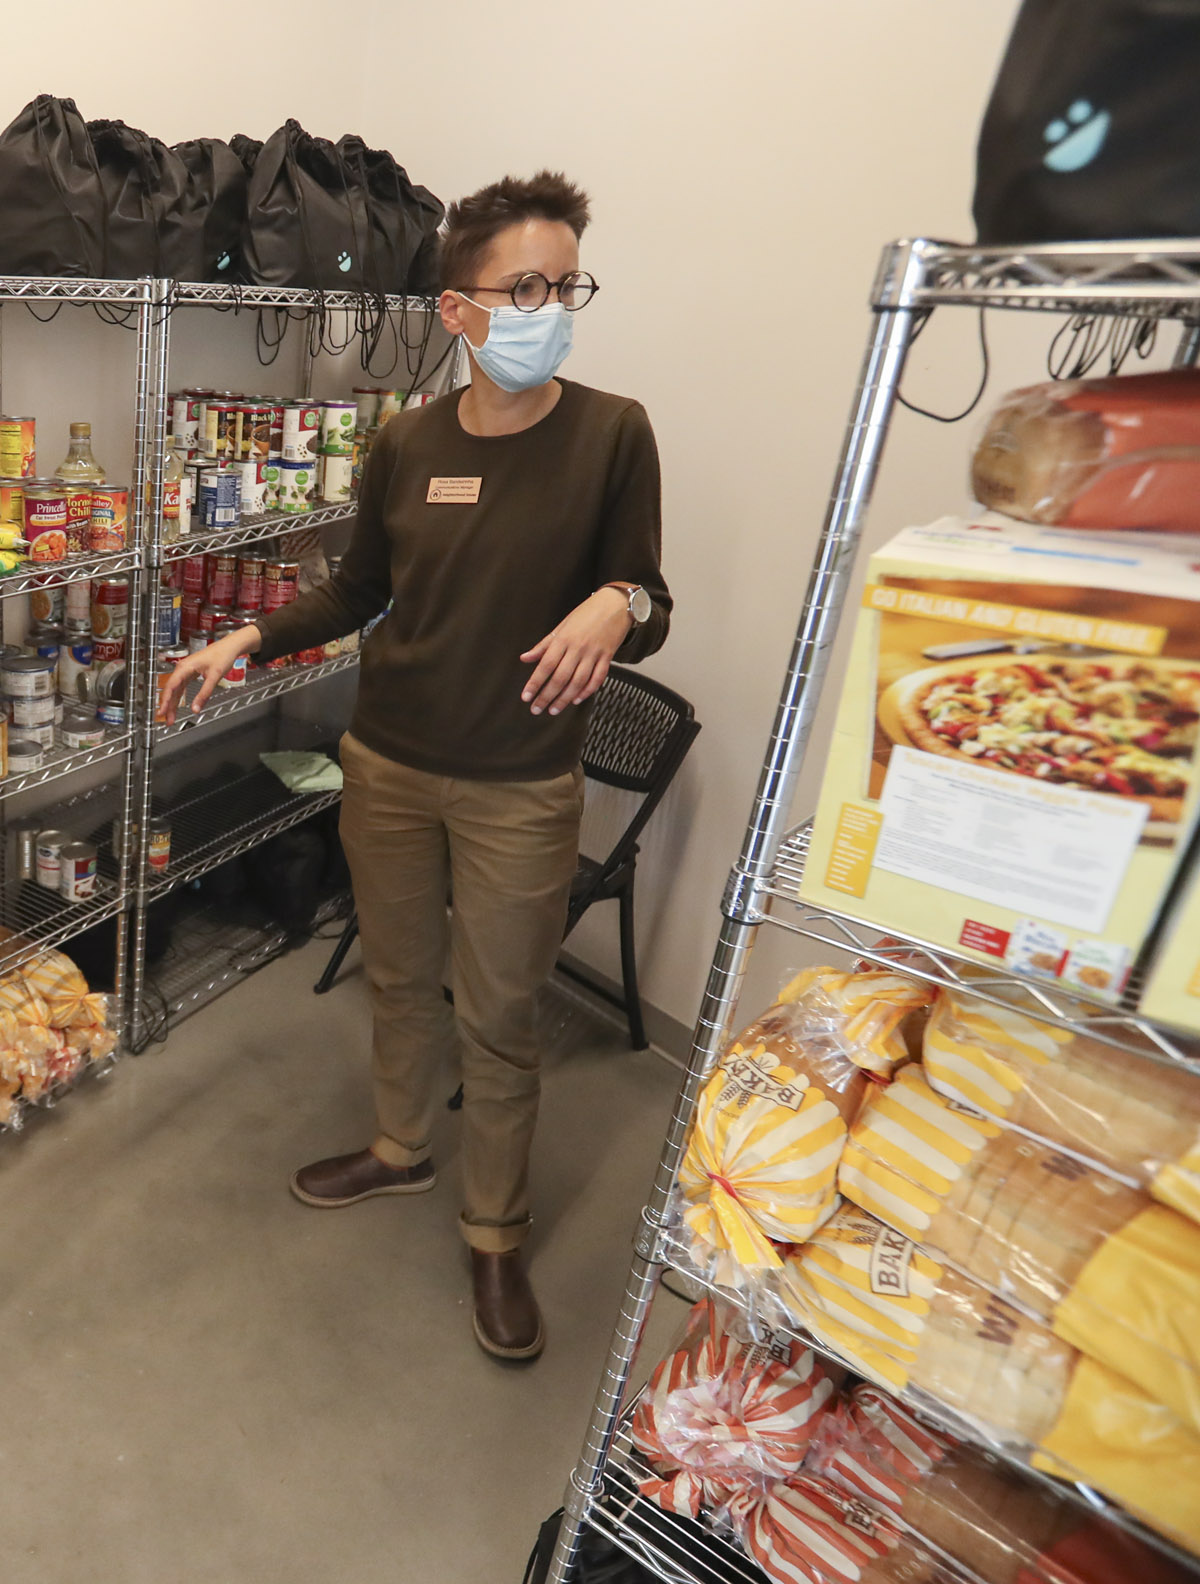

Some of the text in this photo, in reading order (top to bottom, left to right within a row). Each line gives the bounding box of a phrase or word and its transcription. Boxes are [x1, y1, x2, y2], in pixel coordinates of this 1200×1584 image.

[92, 499, 110, 508] alley
[164, 492, 179, 505] Ka
[900, 592, 969, 619] ITALIAN
[970, 604, 1014, 627] AND
[1014, 611, 1094, 641] GLUTEN
[96, 641, 123, 658] mply
[878, 1231, 909, 1290] BAK
